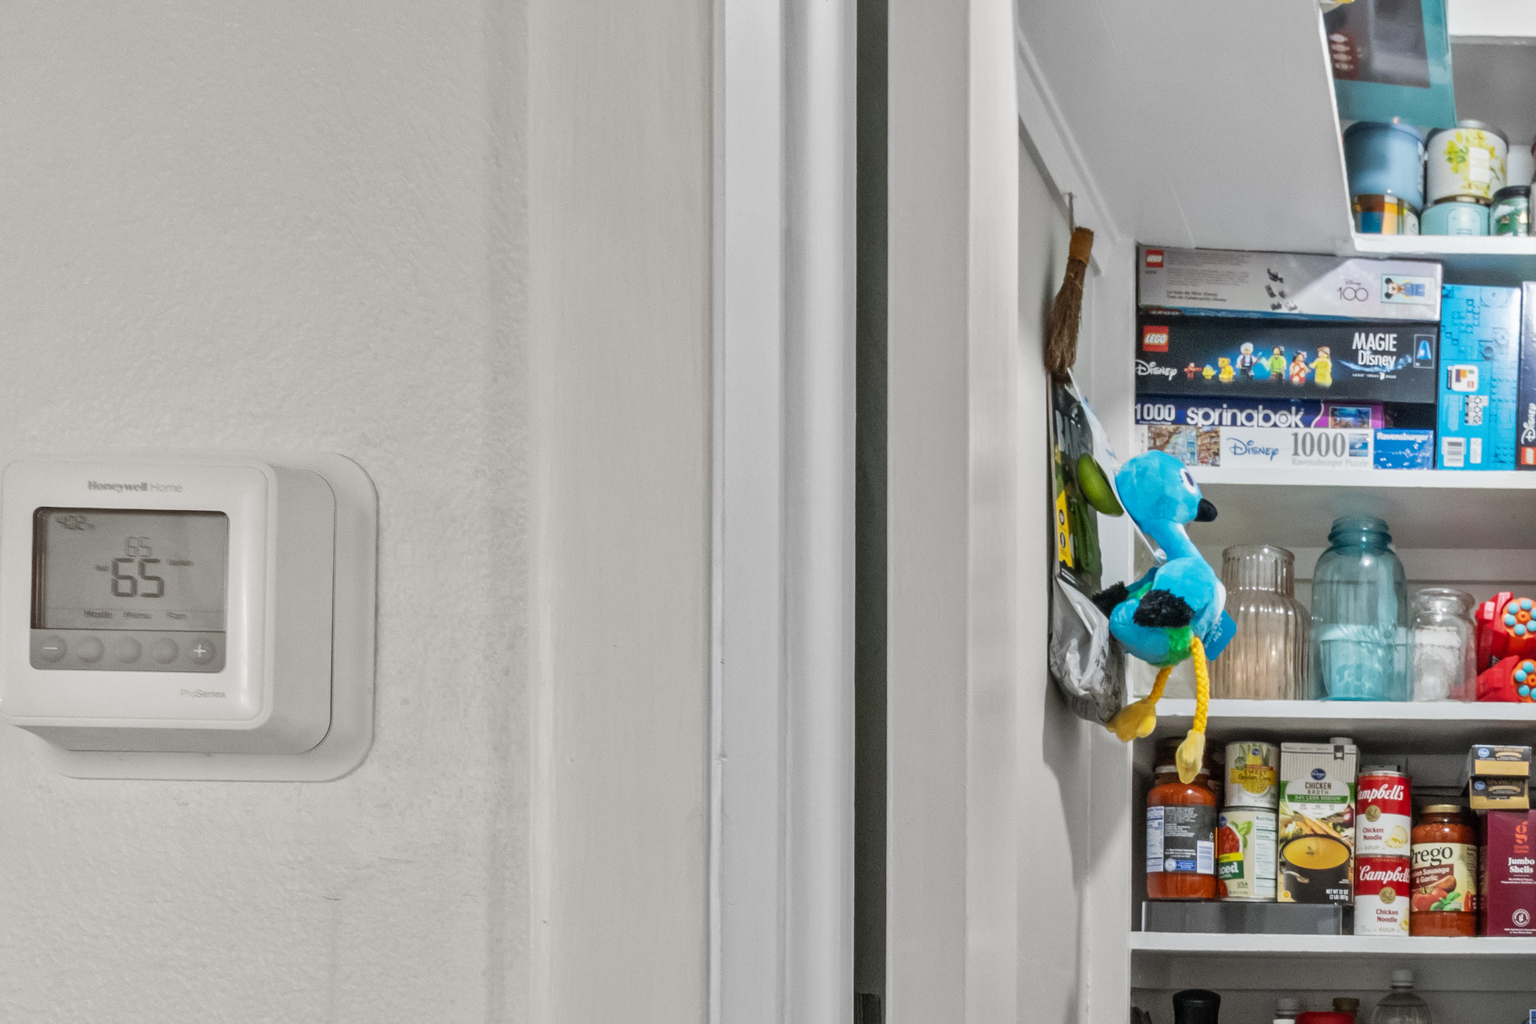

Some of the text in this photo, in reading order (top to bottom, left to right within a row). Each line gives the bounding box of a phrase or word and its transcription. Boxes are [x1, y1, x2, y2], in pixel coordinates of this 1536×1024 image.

[1336, 286, 1369, 302] 100
[1144, 331, 1168, 346] LEGO
[1352, 332, 1398, 352] MAGIE
[1358, 349, 1397, 367] Disney
[1134, 358, 1177, 381] Disney
[1135, 403, 1305, 429] 1000 springbok
[1291, 431, 1346, 458] 1000
[1376, 432, 1430, 442] Ravensburger
[1226, 437, 1280, 462] Disney
[1291, 458, 1369, 468] Ravensburger Puzzle
[88, 481, 183, 493] Honeywell Home
[110, 557, 165, 599] 65
[180, 689, 226, 699] ProSeries
[1304, 781, 1332, 790] CHICKEN
[1357, 783, 1405, 803] ampbell's
[1508, 857, 1535, 866] Jumbo
[1422, 866, 1450, 876] Sausage
[1509, 865, 1534, 874] Shells
[1420, 875, 1439, 883] Garlic
